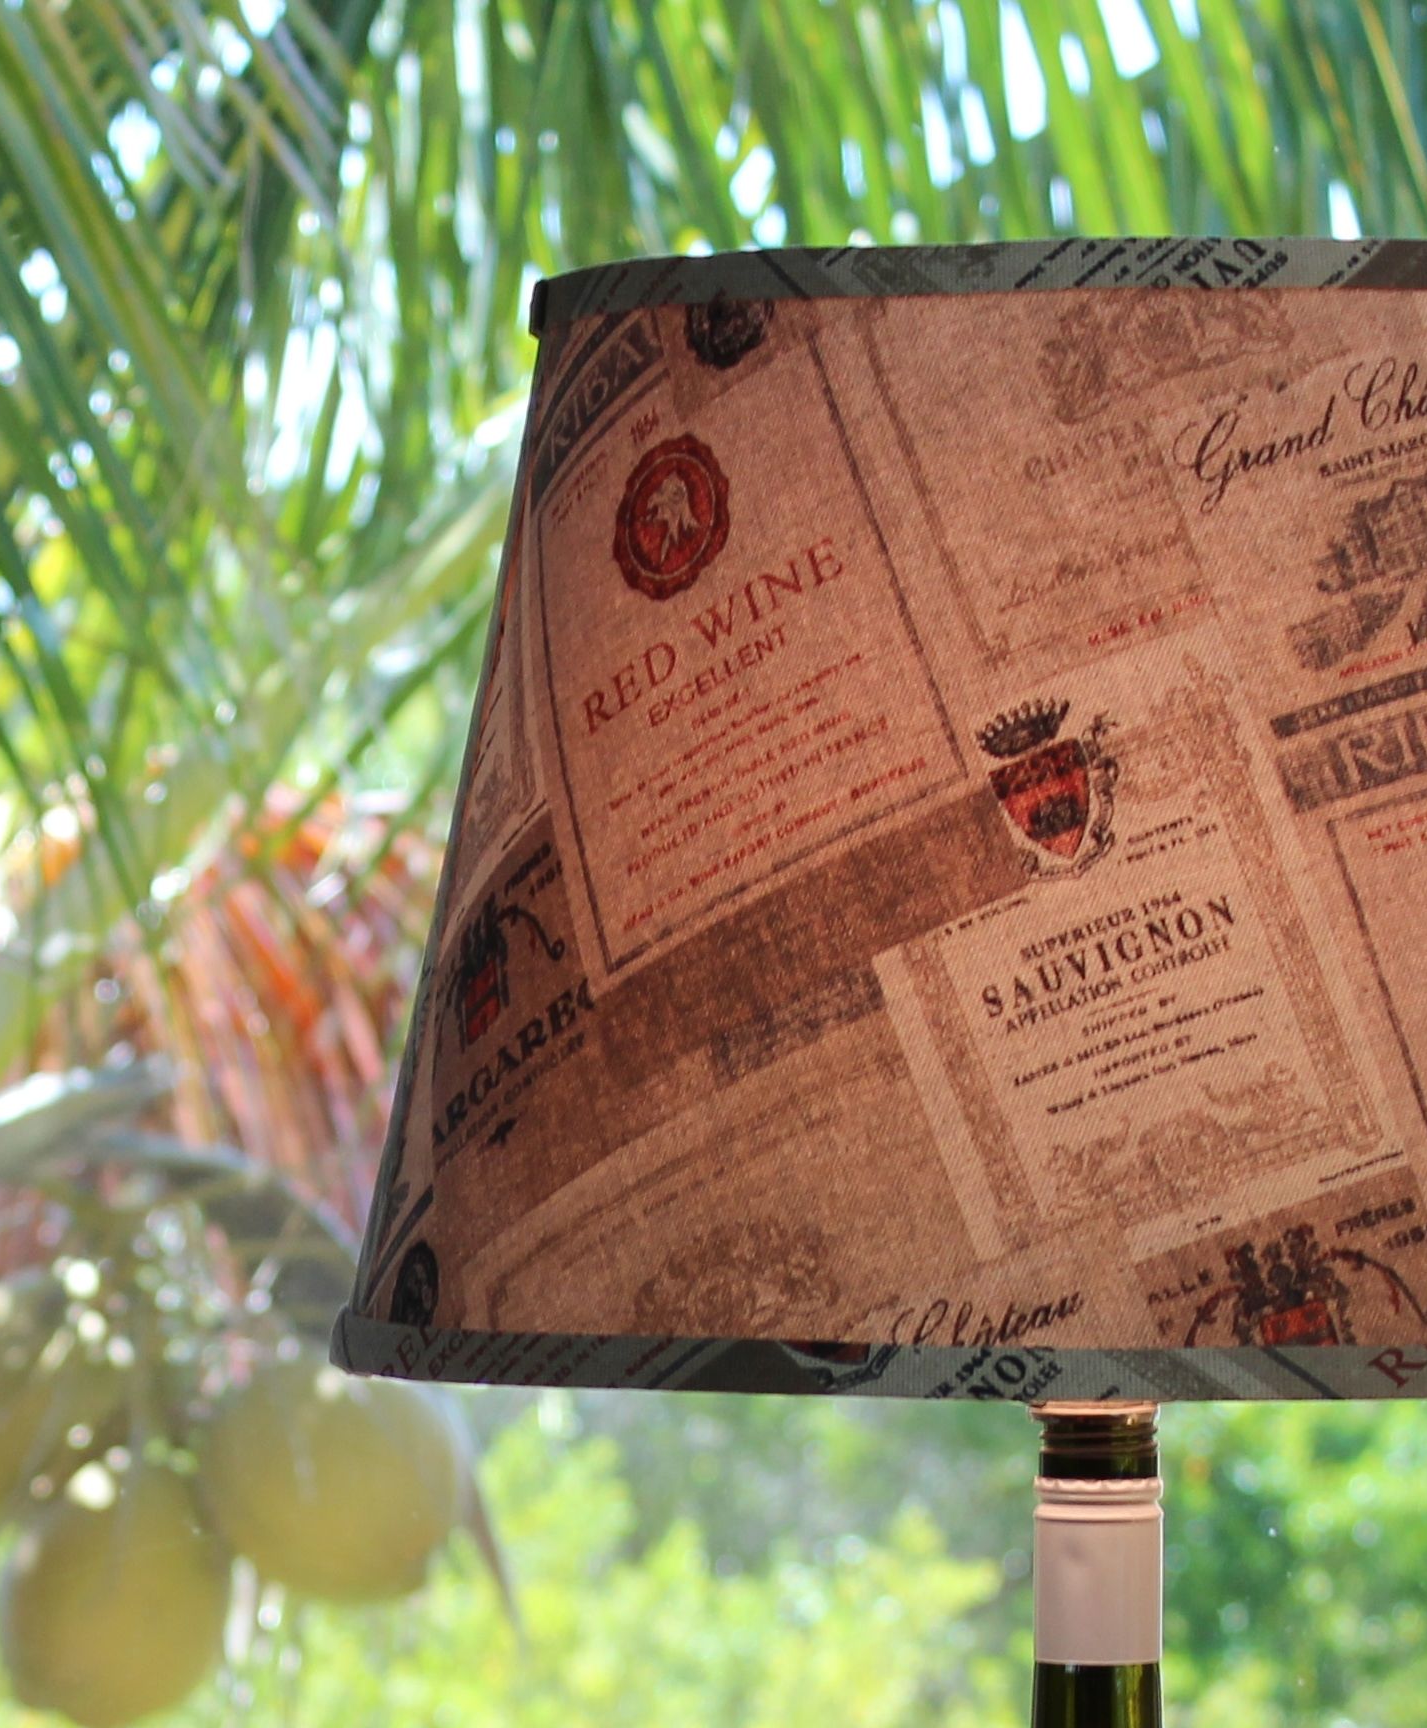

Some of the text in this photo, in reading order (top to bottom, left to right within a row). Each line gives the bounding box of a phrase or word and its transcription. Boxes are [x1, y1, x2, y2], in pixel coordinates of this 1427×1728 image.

[1174, 394, 1336, 513] Grand
[583, 644, 676, 735] RED
[692, 538, 844, 648] WINE
[648, 626, 787, 727] EXCELLENT
[982, 896, 1234, 1018] SAUVIGNON
